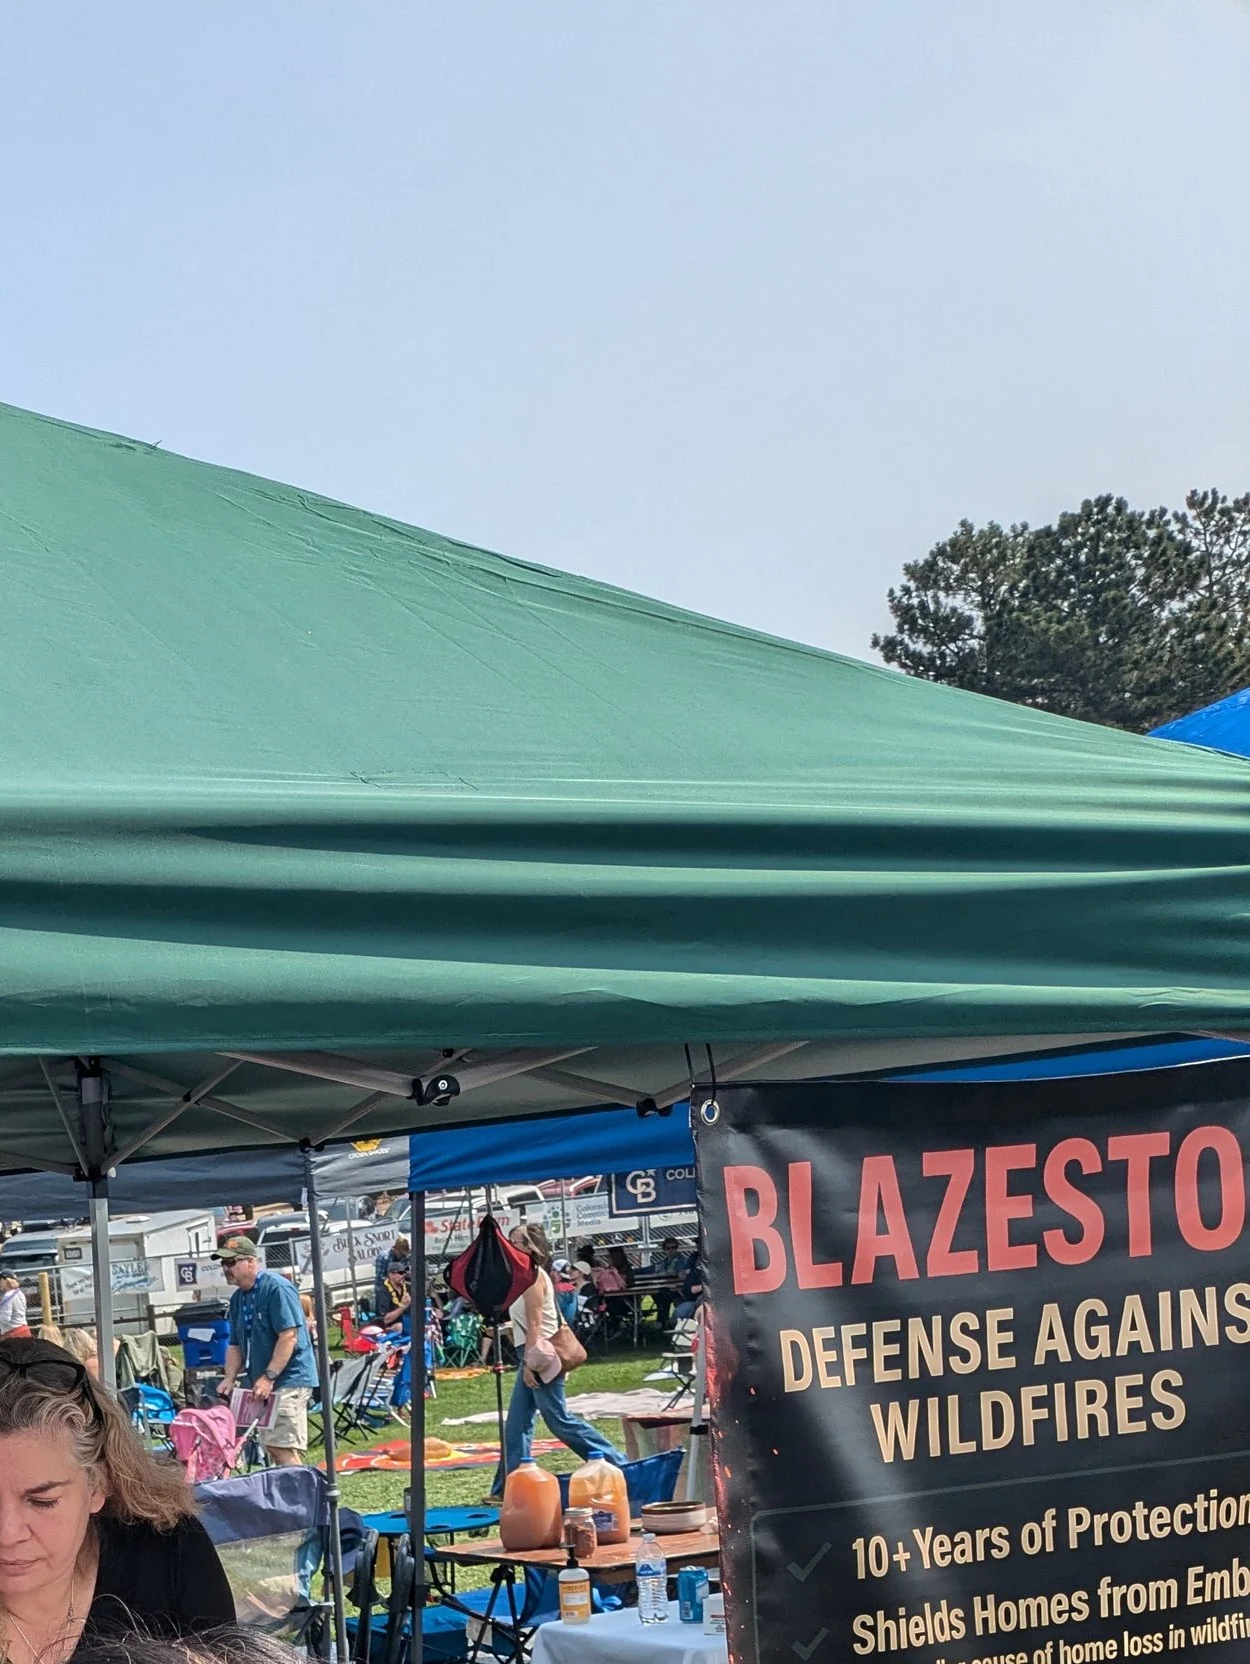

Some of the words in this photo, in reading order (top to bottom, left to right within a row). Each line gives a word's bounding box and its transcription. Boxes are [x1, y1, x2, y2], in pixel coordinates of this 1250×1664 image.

[723, 1125, 1247, 1295] BLAZESTO
[779, 1307, 1016, 1392] DEFENSE
[1035, 1283, 1250, 1365] AGAINS
[871, 1369, 1186, 1463] WILDFIRES
[1021, 1508, 1057, 1555] of
[853, 1599, 966, 1655] Shields
[973, 1590, 1090, 1636] Homes
[1097, 1576, 1178, 1618] from
[1123, 1630, 1164, 1657] loss
[1168, 1624, 1186, 1650] in
